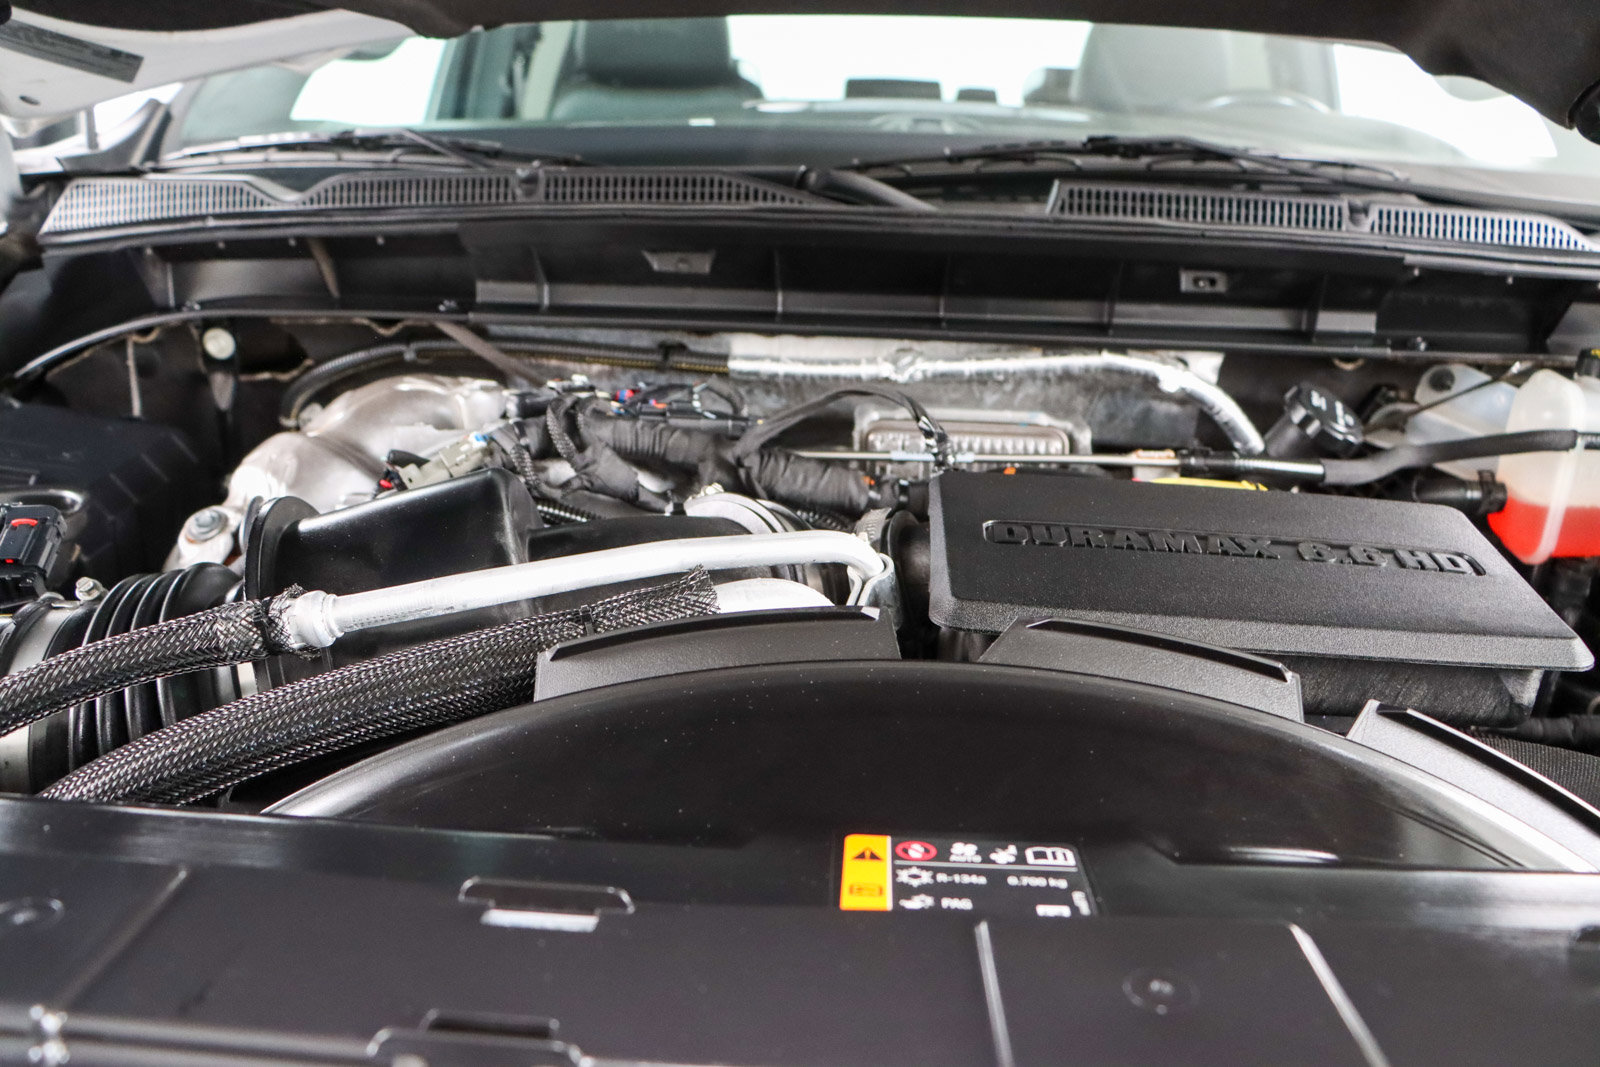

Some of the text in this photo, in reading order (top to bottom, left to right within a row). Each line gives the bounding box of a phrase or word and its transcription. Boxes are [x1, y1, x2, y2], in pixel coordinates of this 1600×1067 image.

[993, 523, 1474, 575] DURAMAX 6.6 HD
[936, 873, 988, 885] R-134a
[1048, 877, 1069, 889] kg
[941, 897, 973, 910] PAG
